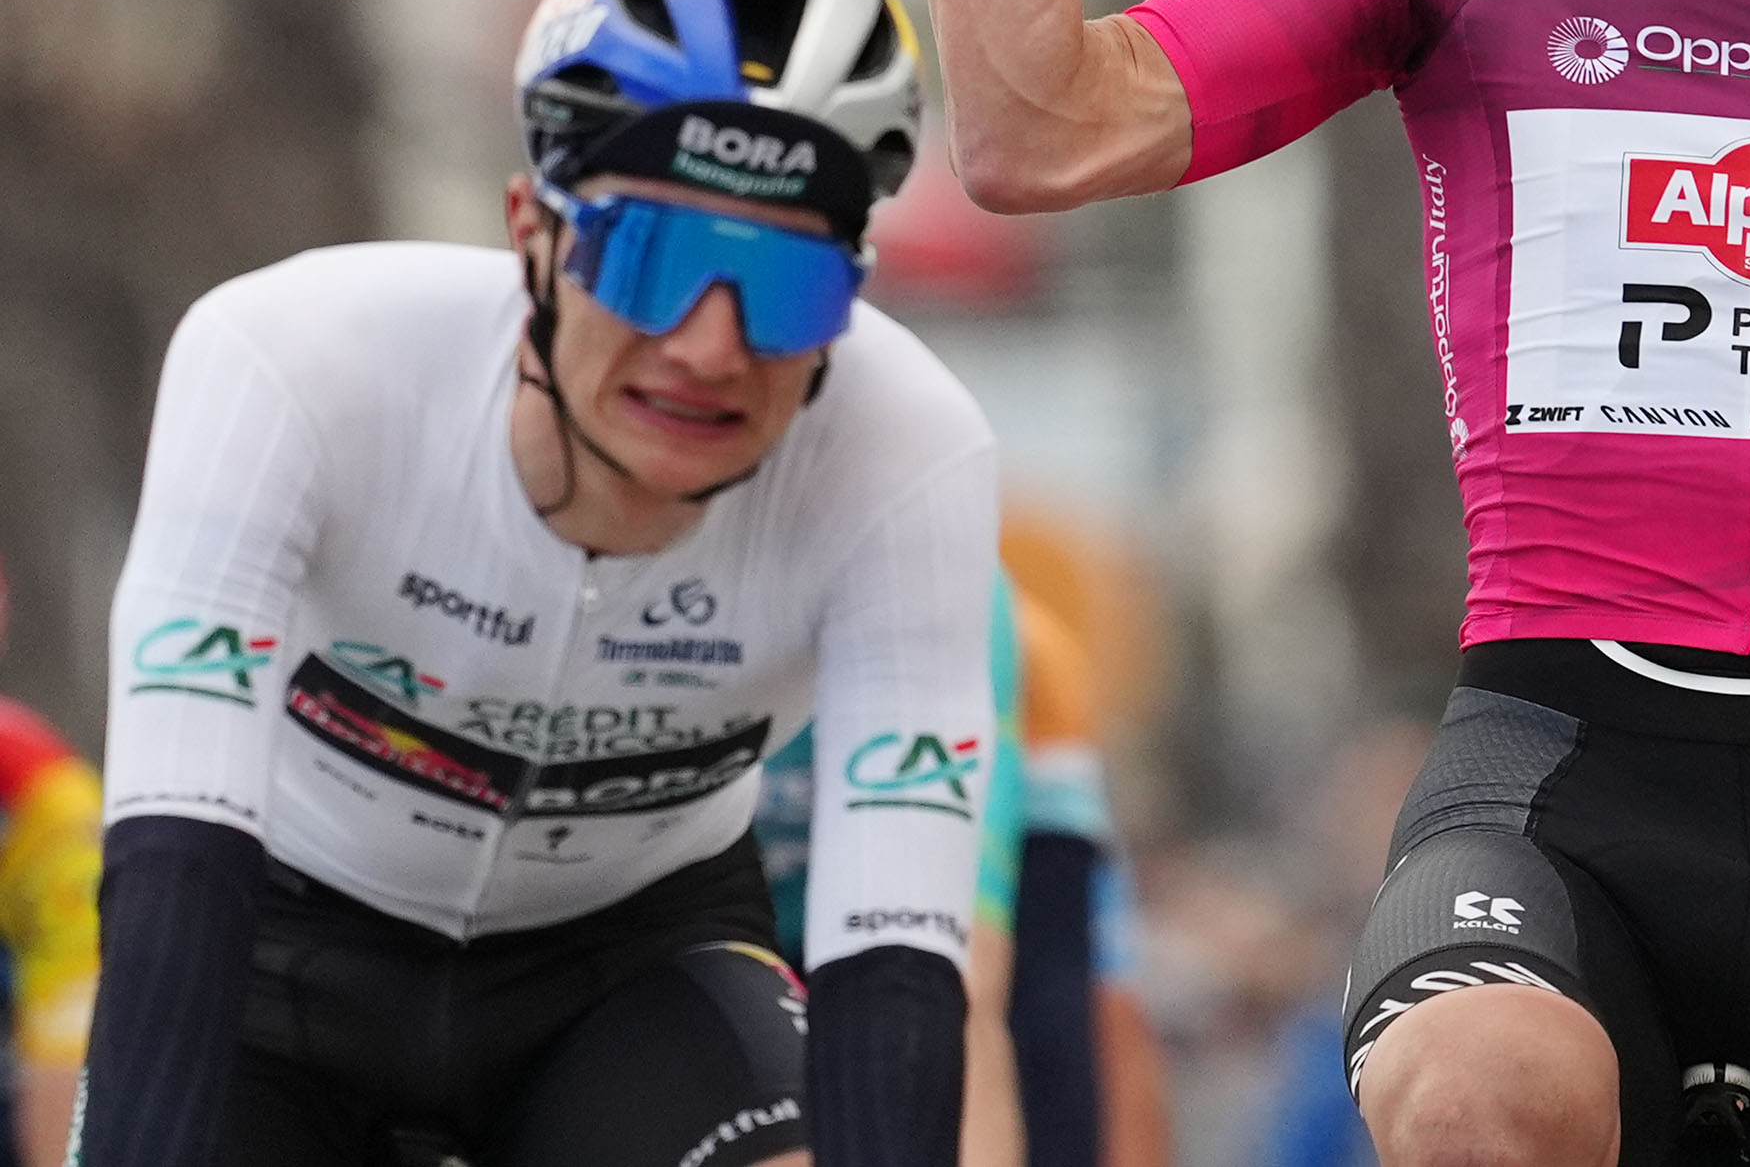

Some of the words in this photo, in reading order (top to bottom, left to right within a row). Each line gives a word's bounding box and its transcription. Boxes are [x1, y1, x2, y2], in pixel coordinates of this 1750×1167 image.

[677, 113, 818, 175] BORA
[1527, 406, 1585, 422] ZWIFT
[1600, 405, 1732, 428] CANYON
[398, 570, 536, 646] sportful
